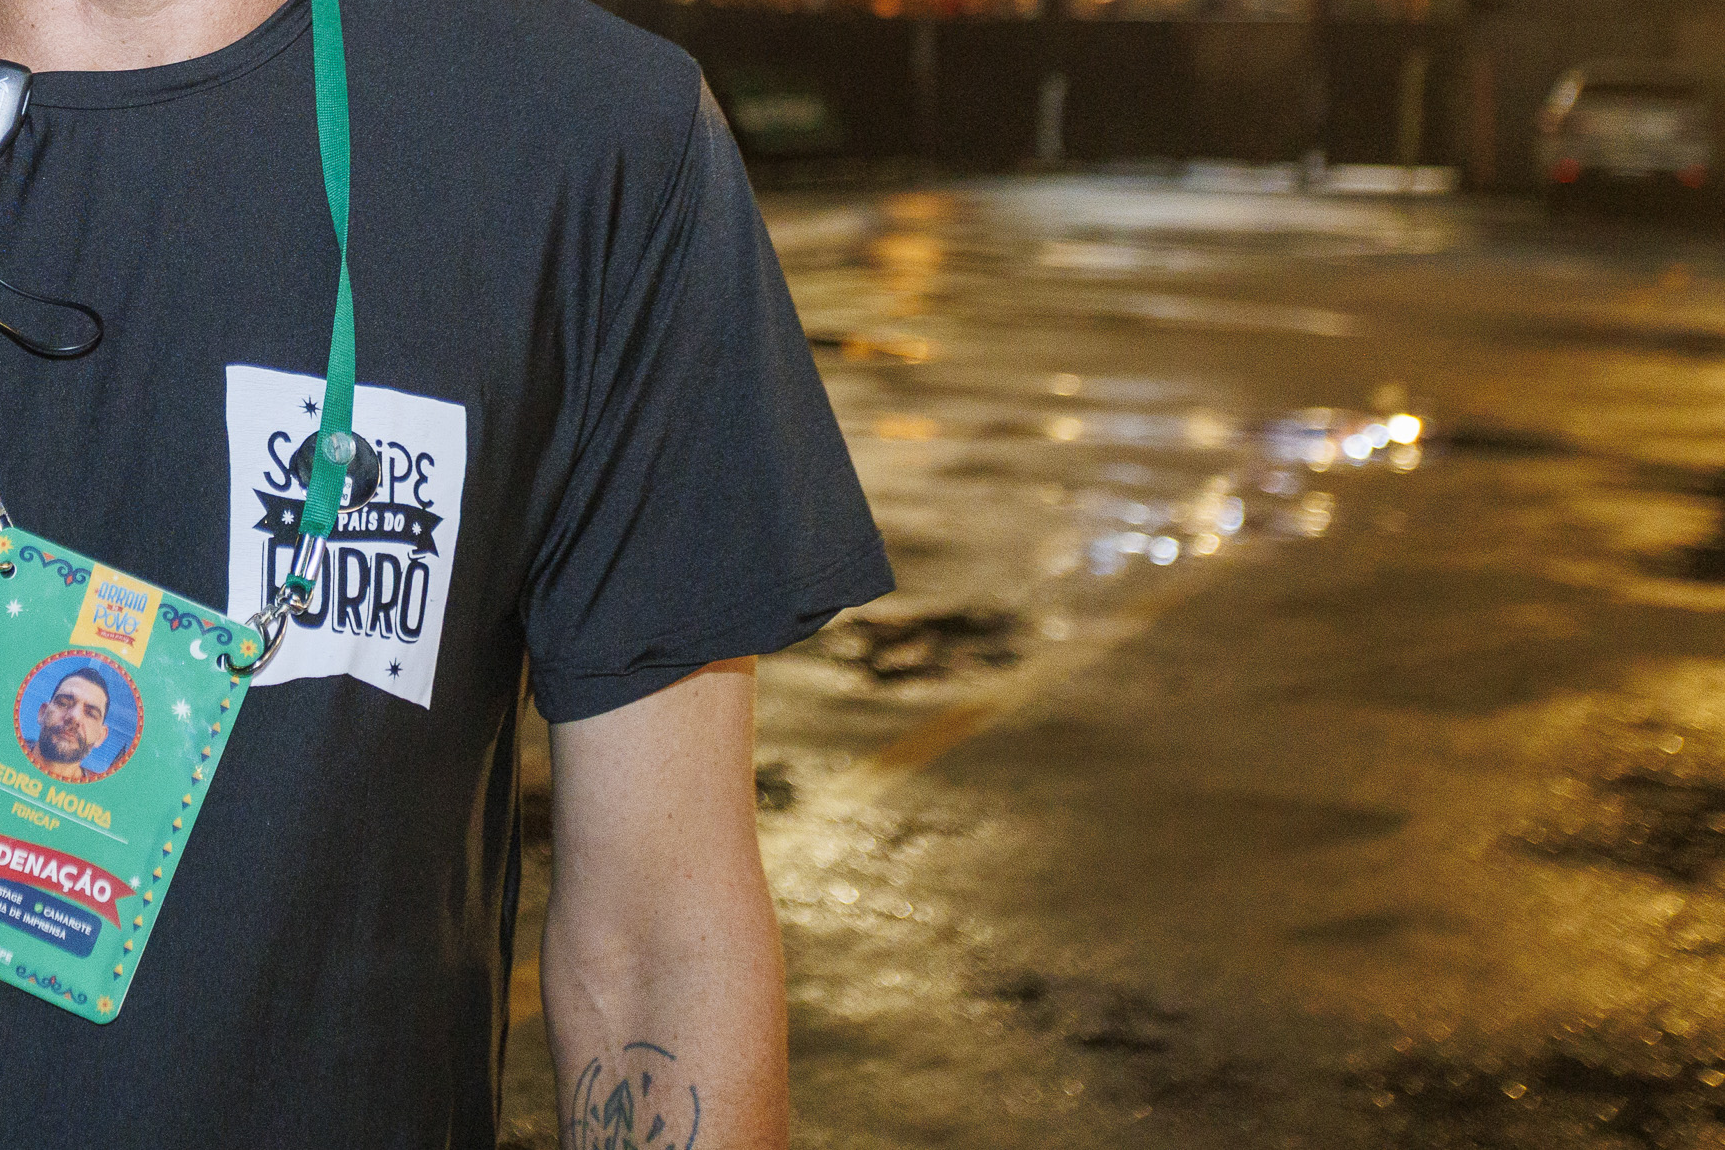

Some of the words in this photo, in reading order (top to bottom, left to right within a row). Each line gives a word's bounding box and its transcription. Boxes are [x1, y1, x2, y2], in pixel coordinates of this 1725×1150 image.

[337, 507, 378, 532] PAÍS
[383, 513, 406, 533] DO
[11, 801, 60, 830] FUNCAP
[45, 785, 112, 829] MOURA
[8, 908, 22, 921] DE
[22, 913, 67, 941] IMPRENSA
[43, 906, 93, 936] CAMAROTE
